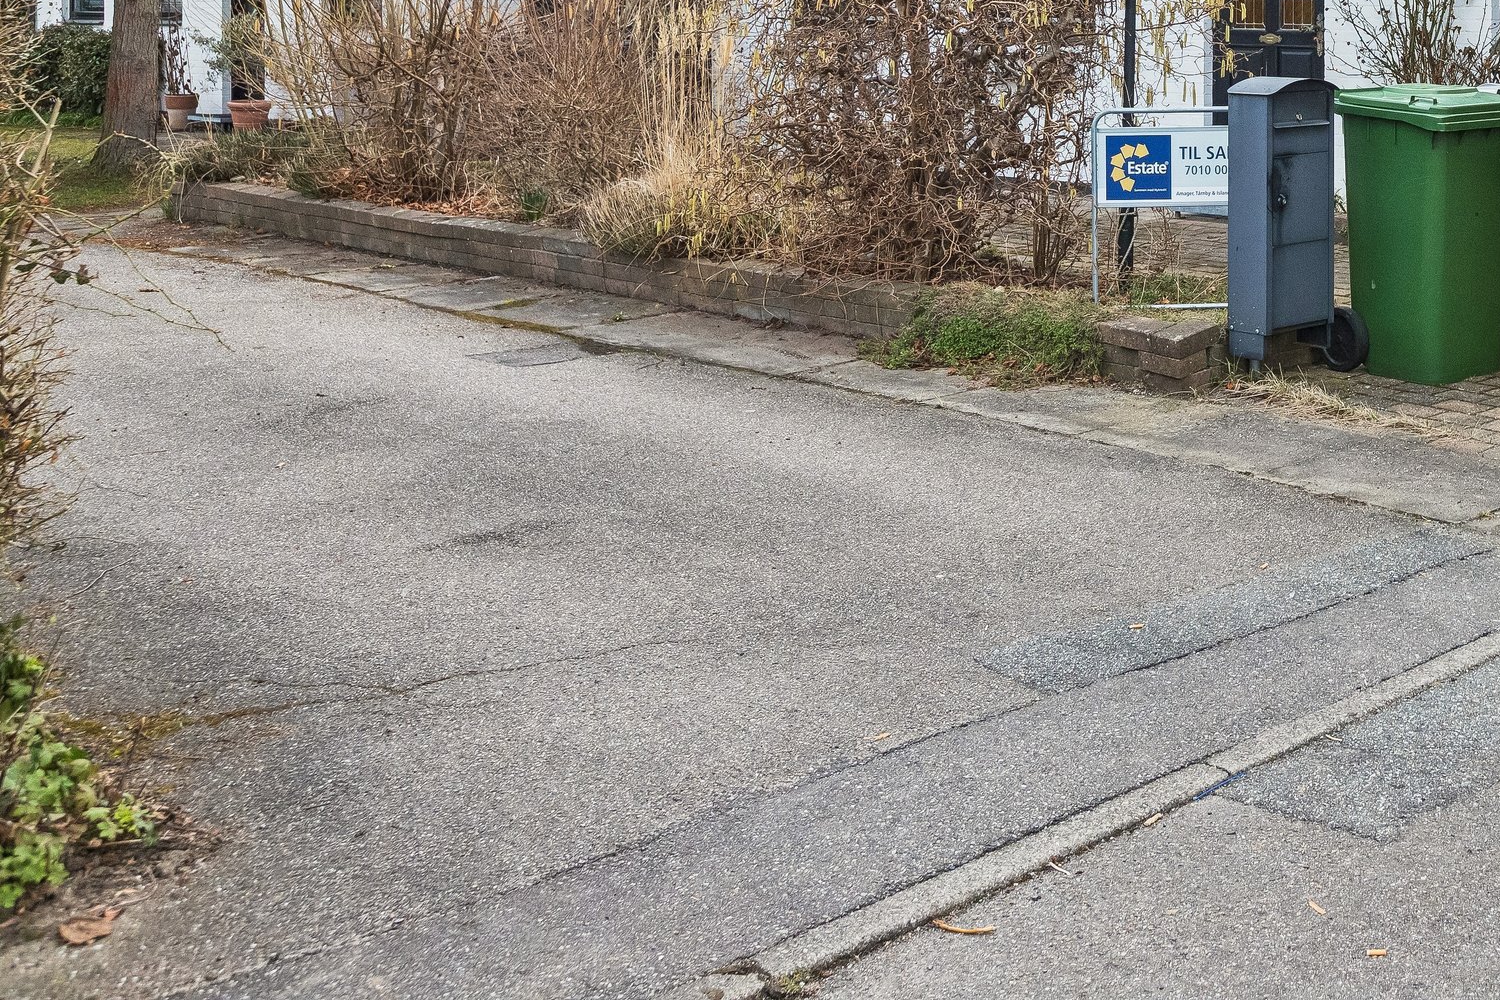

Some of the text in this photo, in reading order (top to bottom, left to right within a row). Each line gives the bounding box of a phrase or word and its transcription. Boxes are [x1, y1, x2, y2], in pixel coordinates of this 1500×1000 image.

[1179, 146, 1229, 160] TIL SA
[1127, 161, 1167, 175] Estate
[1185, 165, 1228, 175] 7010 00
